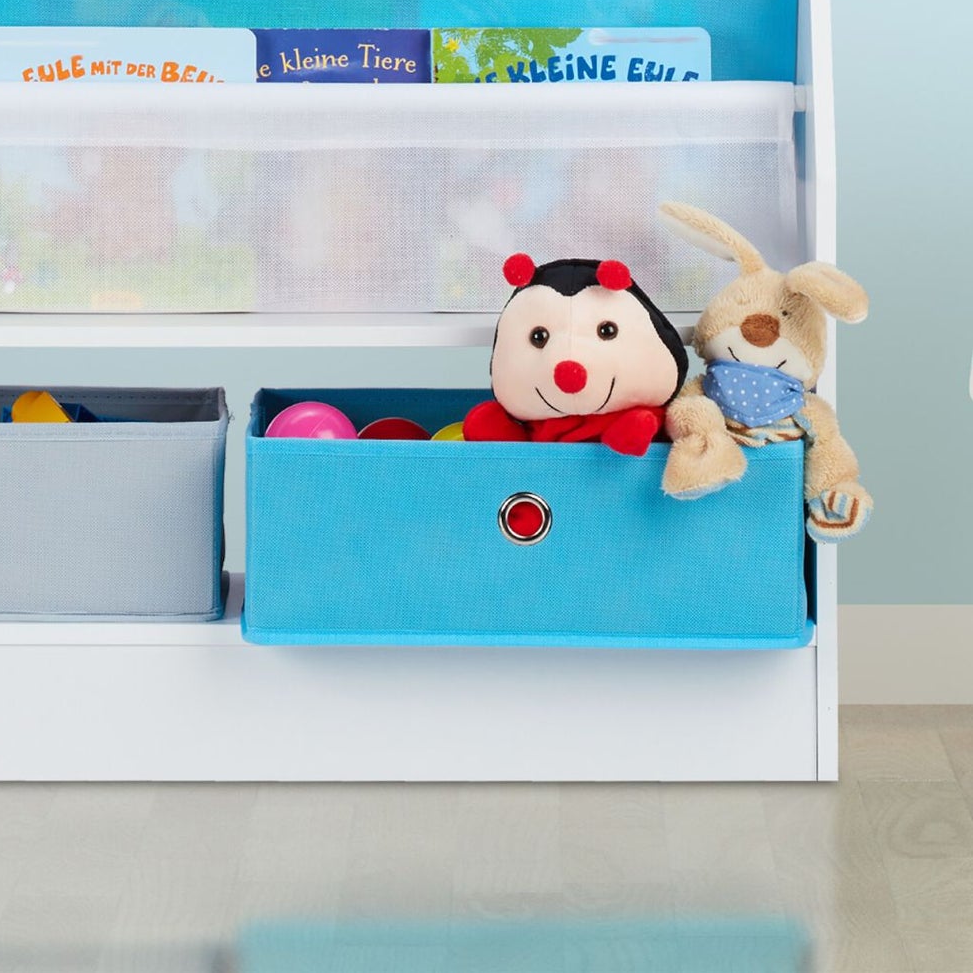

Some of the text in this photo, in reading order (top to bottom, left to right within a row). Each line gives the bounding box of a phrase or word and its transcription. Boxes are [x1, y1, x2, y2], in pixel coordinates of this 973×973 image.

[279, 47, 349, 74] kleine
[358, 43, 416, 73] Tiere
[126, 63, 155, 78] DER
